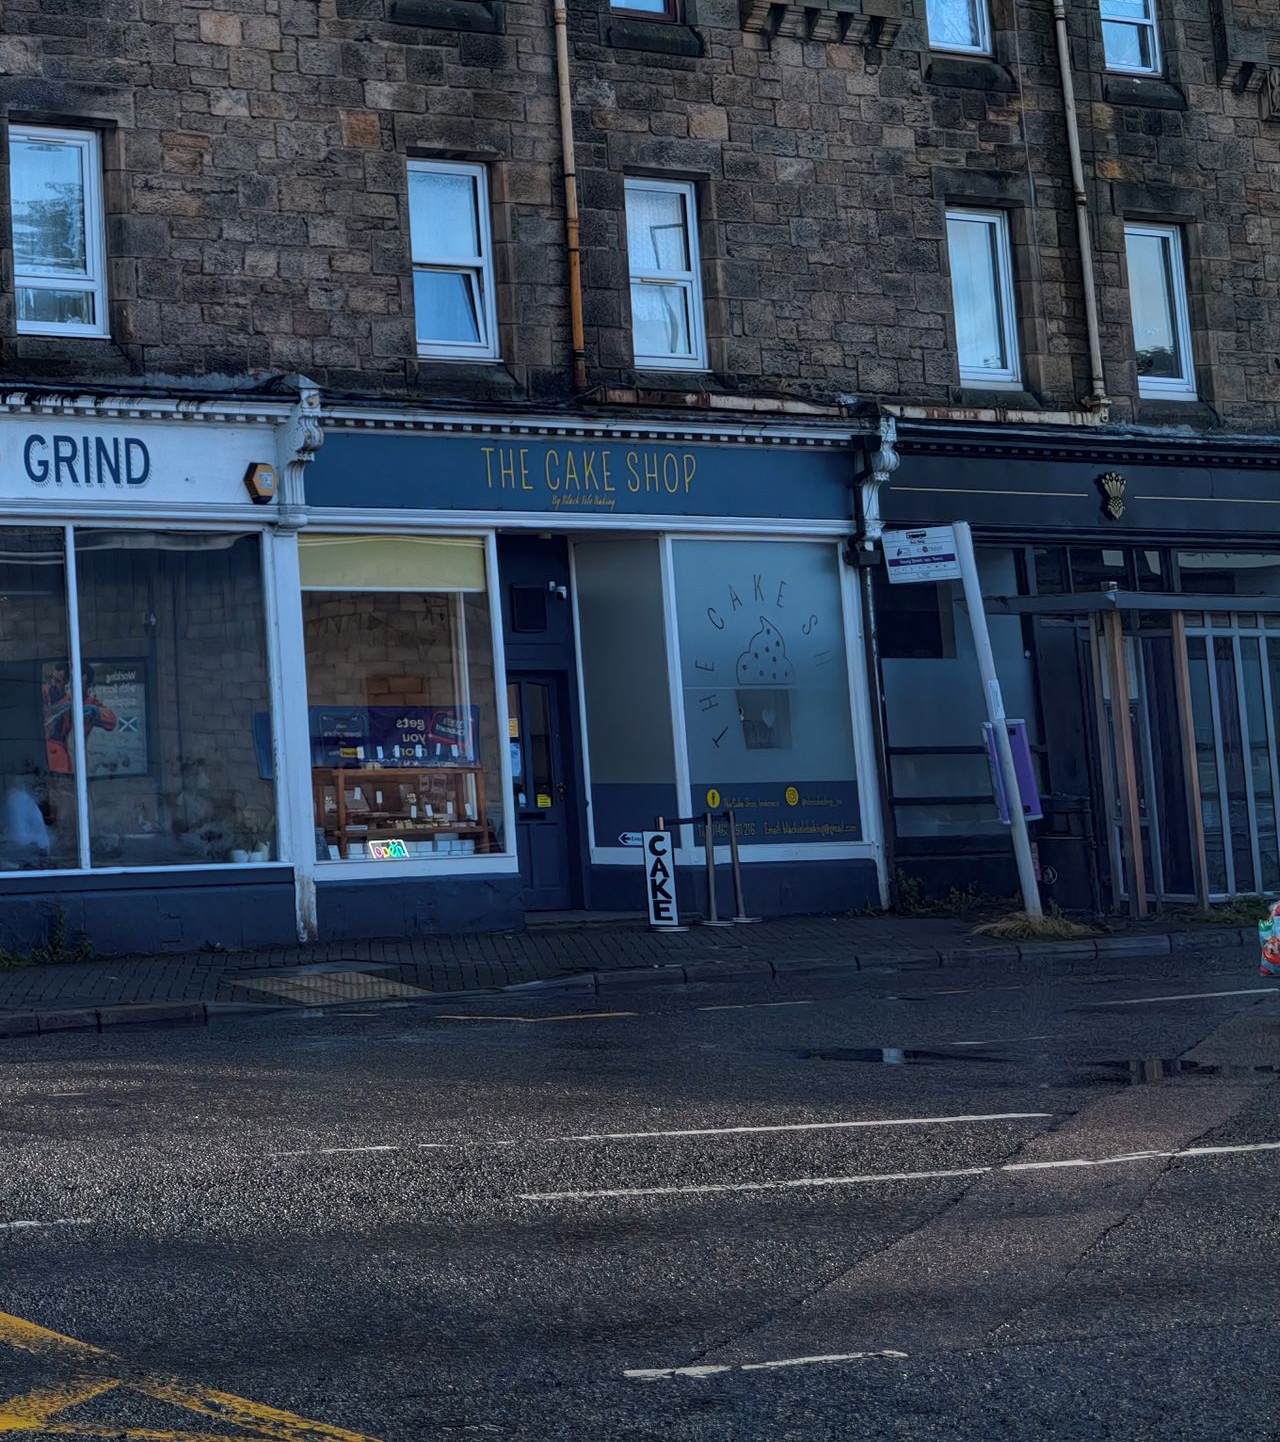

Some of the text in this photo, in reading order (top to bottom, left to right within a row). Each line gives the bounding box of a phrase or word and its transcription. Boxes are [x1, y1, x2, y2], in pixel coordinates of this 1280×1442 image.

[23, 433, 151, 488] GRIND
[481, 447, 697, 494] THE CAKE SHOP
[708, 573, 788, 630] CAKE
[648, 834, 674, 921] CAKE
